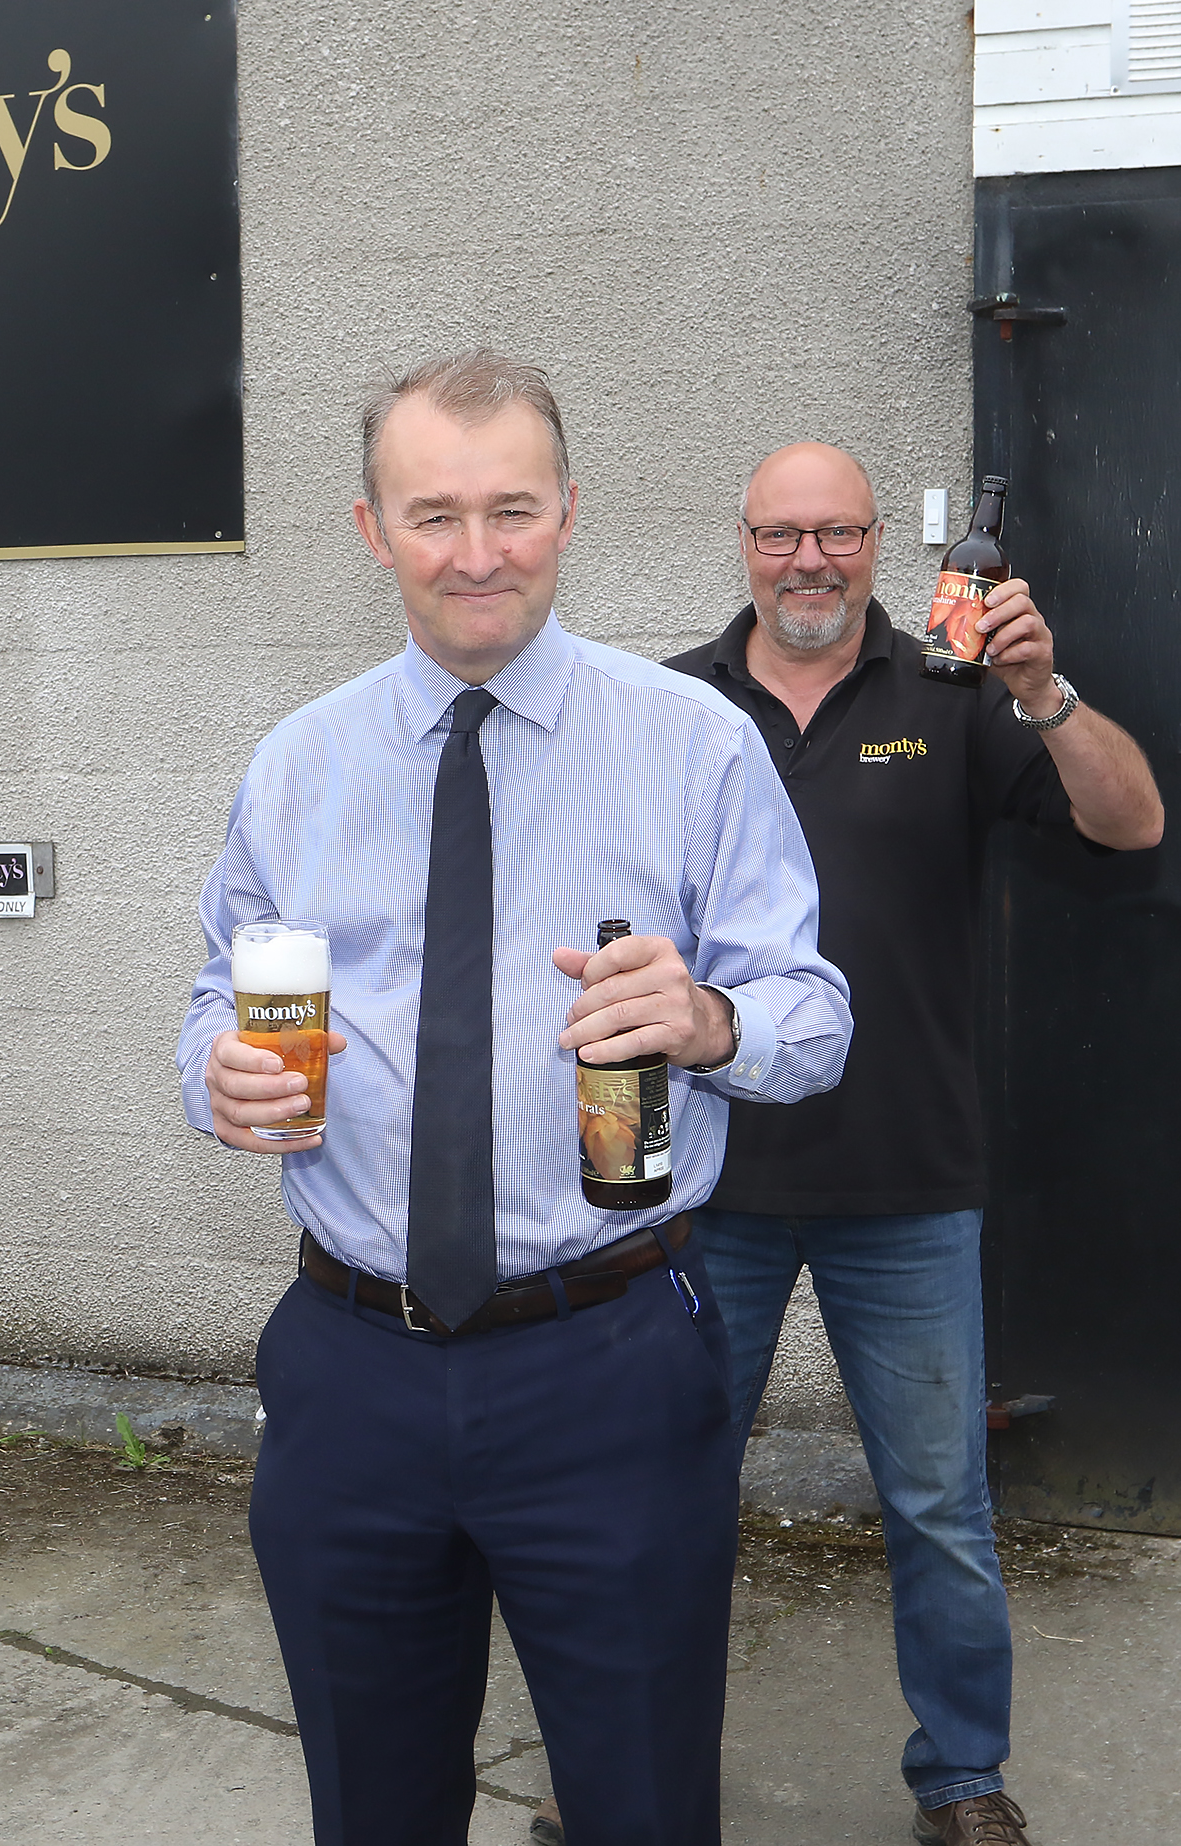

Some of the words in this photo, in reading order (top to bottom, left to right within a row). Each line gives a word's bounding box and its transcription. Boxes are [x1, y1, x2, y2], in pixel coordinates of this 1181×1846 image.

[860, 737, 928, 760] monty's
[859, 752, 891, 765] brewery
[247, 999, 317, 1026] monty's
[585, 1103, 606, 1116] rats
